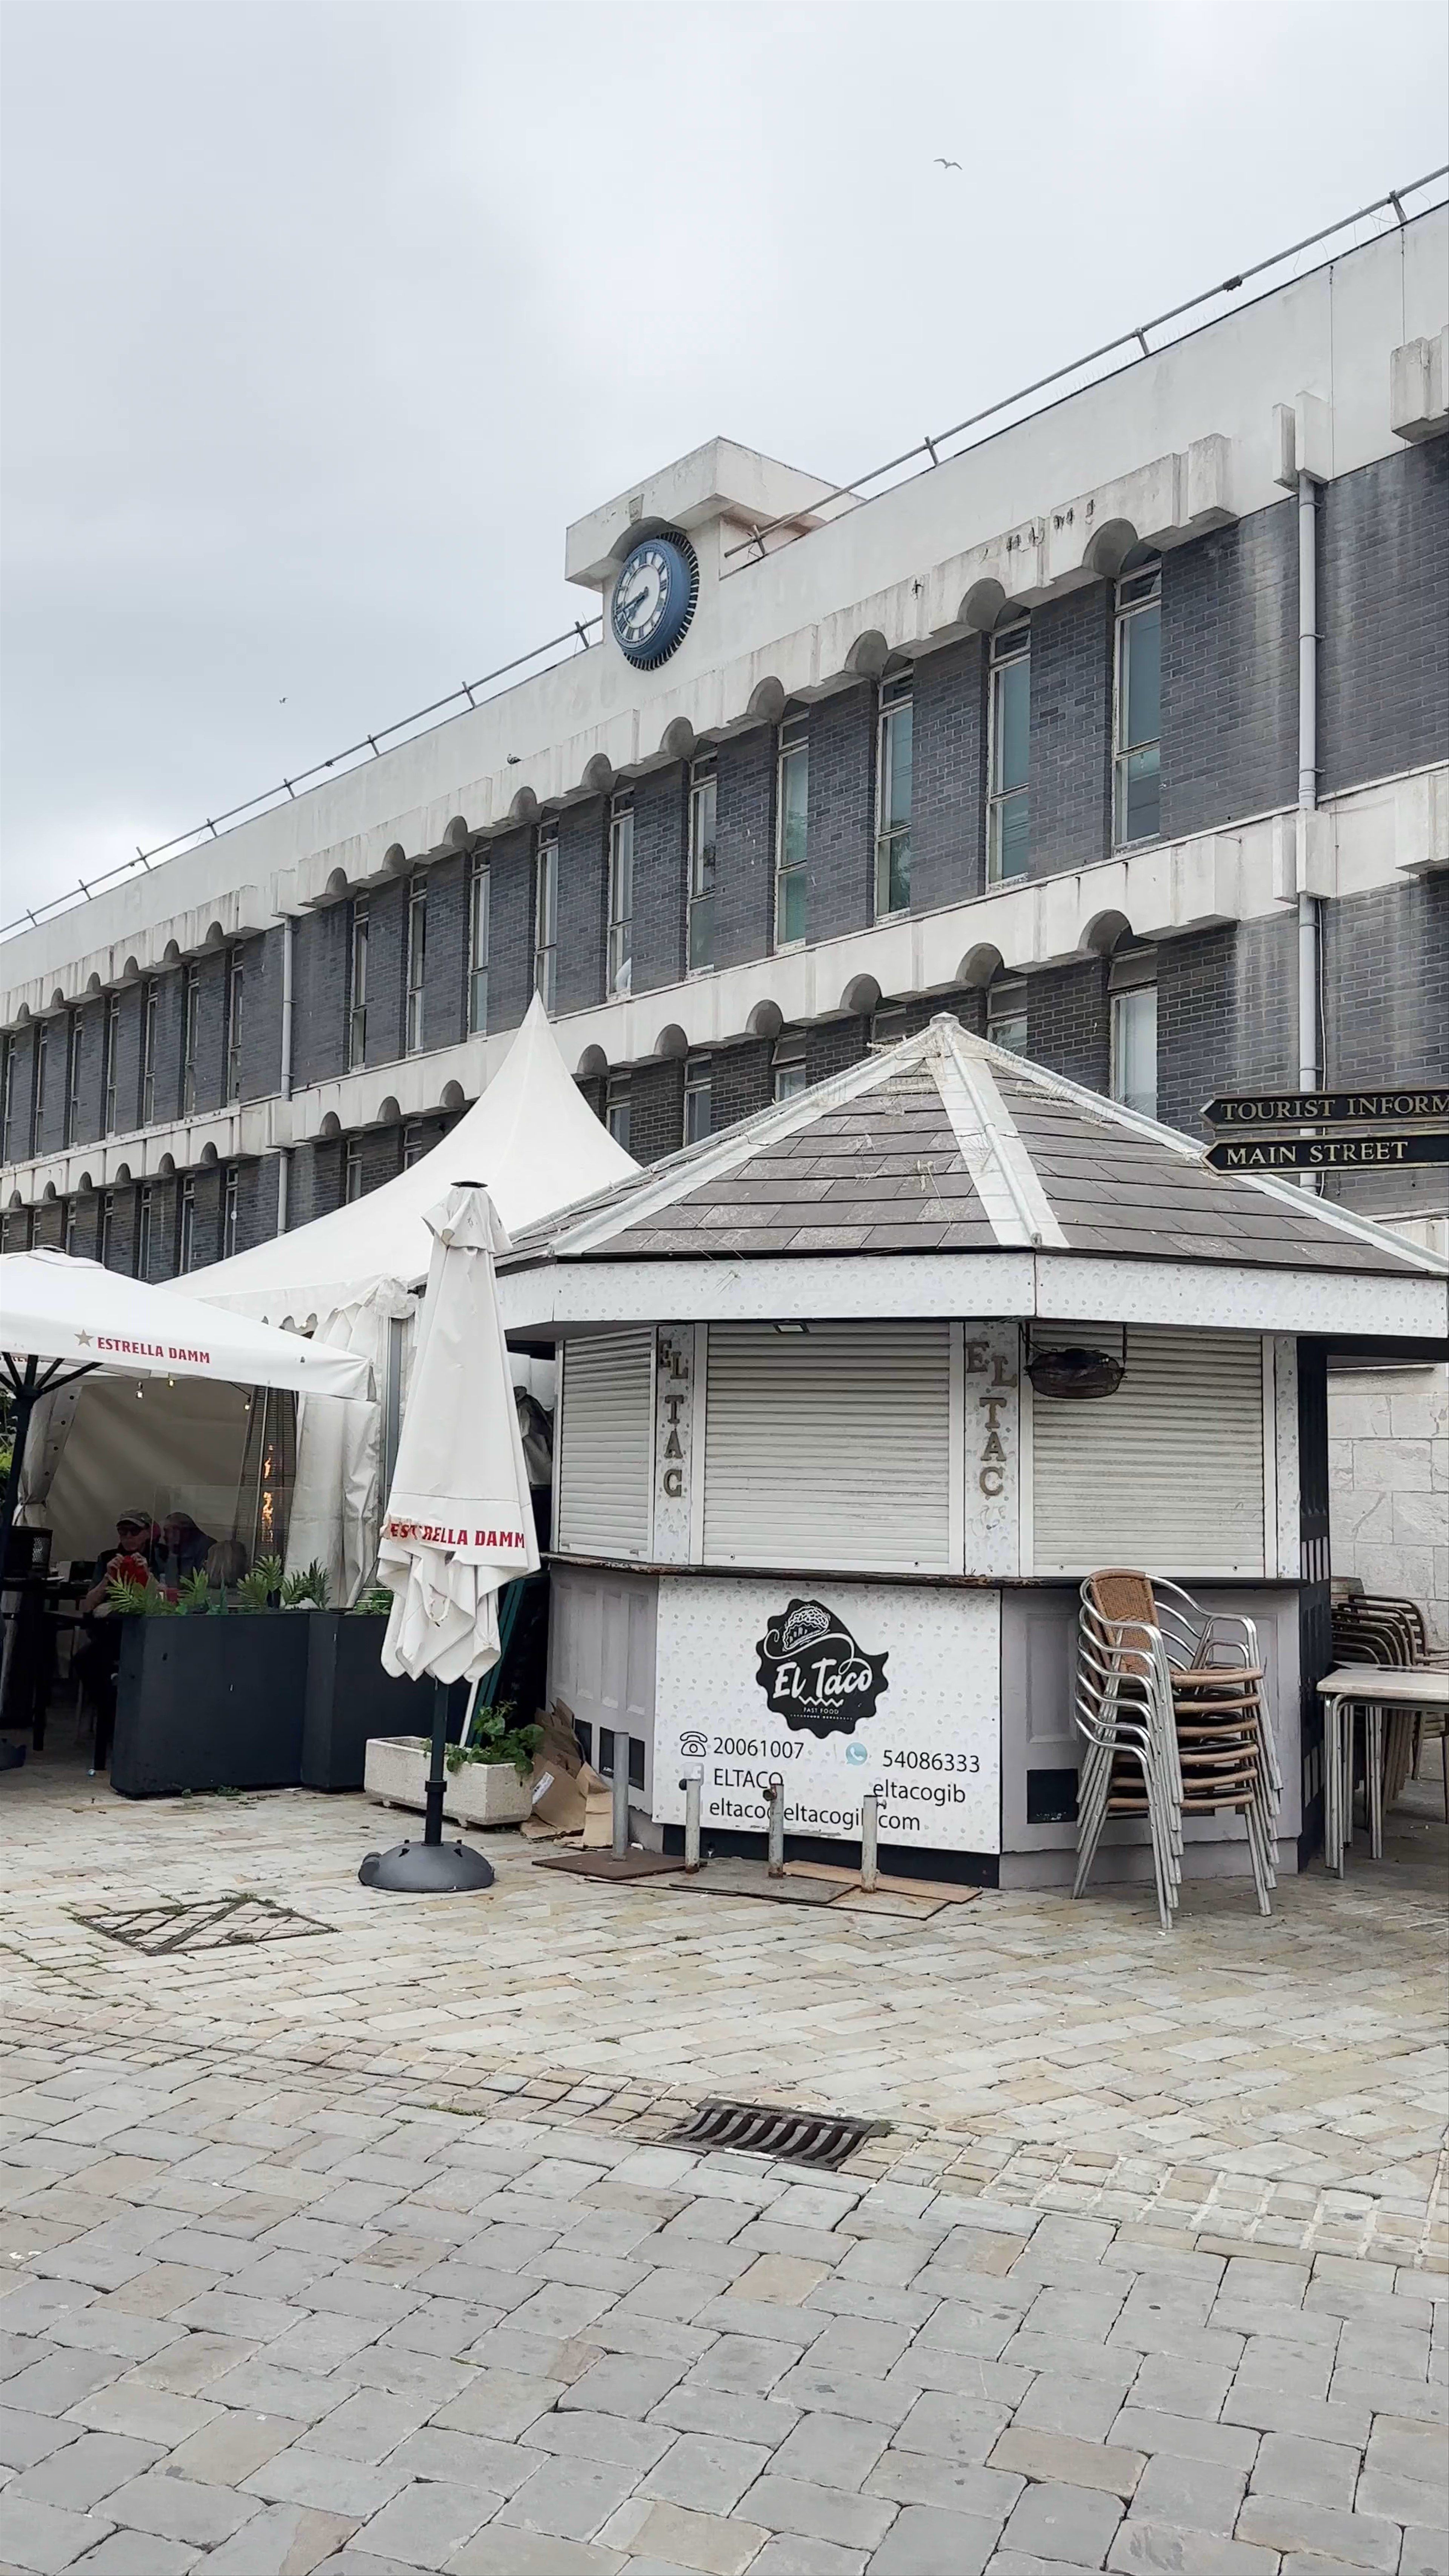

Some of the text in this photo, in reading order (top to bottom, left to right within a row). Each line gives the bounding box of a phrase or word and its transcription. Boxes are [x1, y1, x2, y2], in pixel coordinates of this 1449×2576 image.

[1221, 1099, 1335, 1121] TOURIST
[1227, 1141, 1408, 1165] MAIN STREET
[97, 1337, 210, 1363] ESTRELLA DAMM
[391, 1523, 525, 1549] ESTRELLA DAMM
[772, 1658, 873, 1698] El Taco
[714, 1737, 804, 1759] 20061007
[882, 1750, 980, 1773] 54086333
[714, 1768, 783, 1789] ELTACO
[873, 1779, 966, 1806] eltacogib
